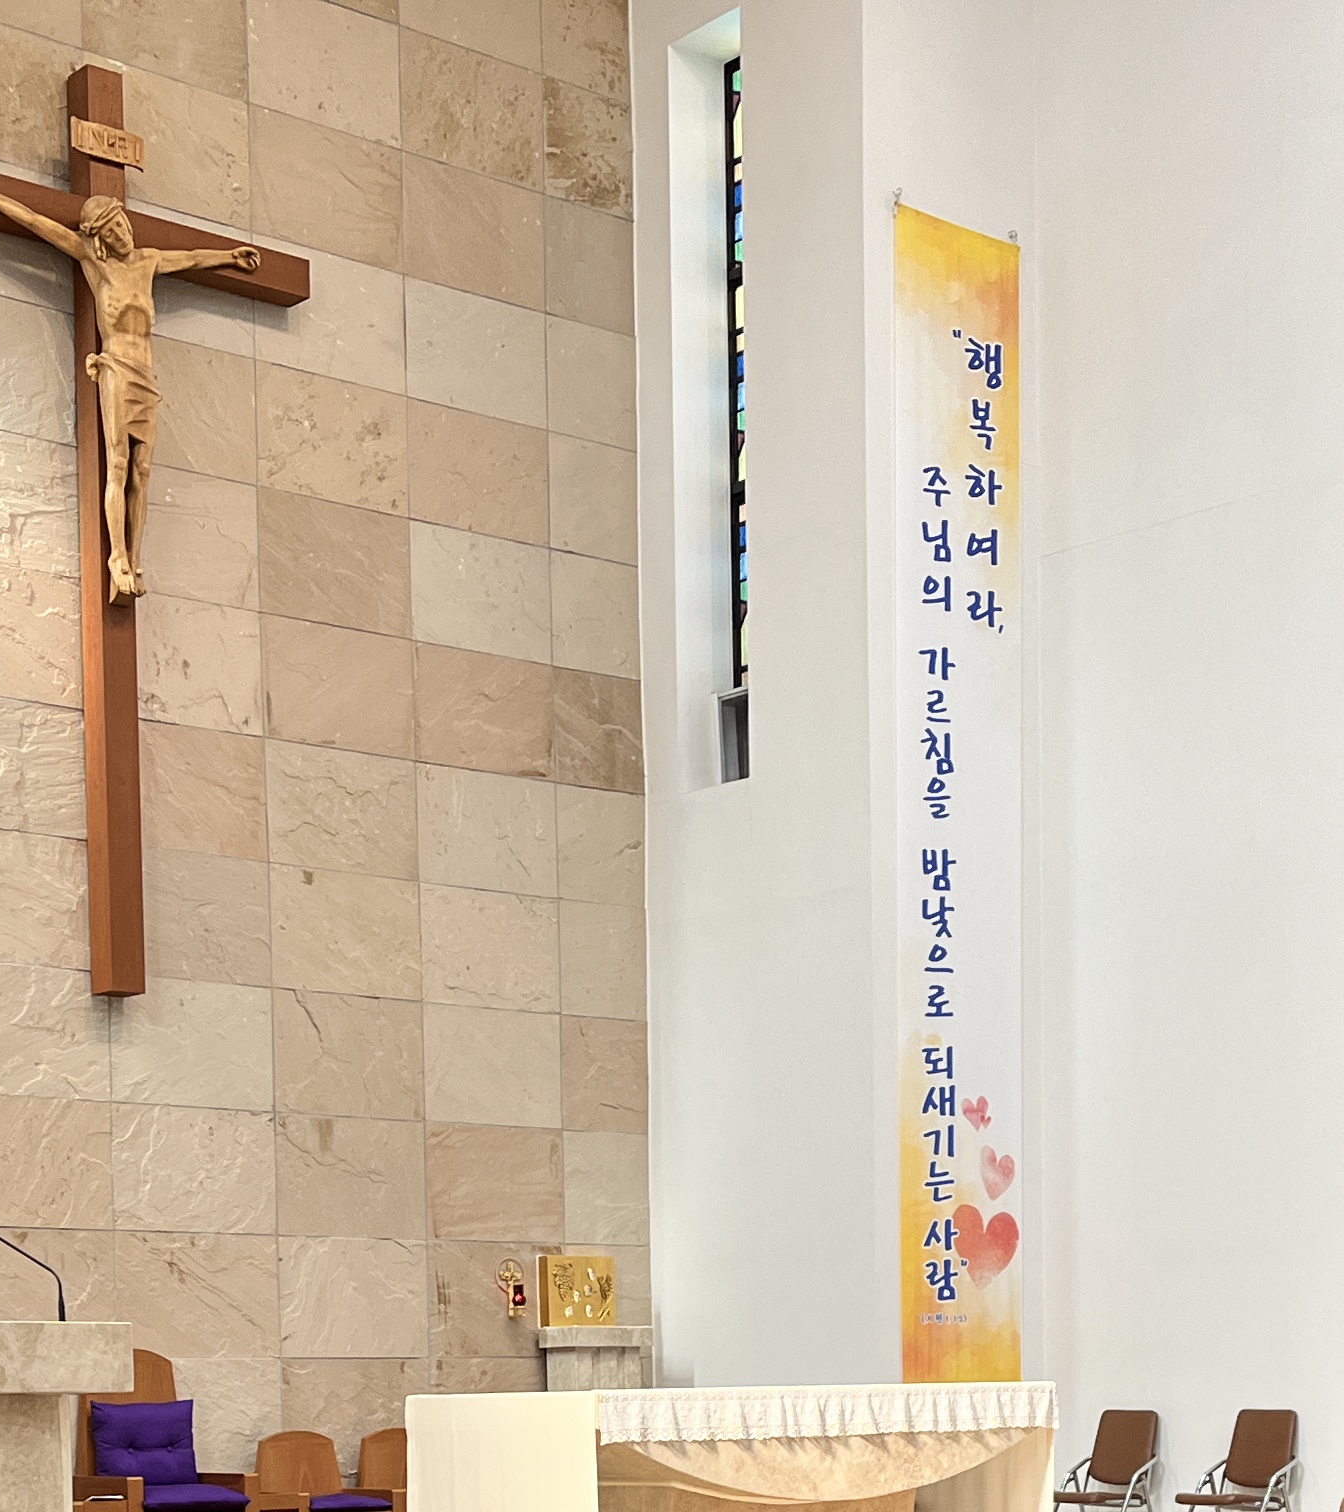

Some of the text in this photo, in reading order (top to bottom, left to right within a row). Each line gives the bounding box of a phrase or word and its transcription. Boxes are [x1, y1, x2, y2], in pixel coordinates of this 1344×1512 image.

[921, 465, 952, 613] 주님의
[918, 646, 956, 819] 가르침을
[921, 847, 956, 1019] 밤낮으로
[921, 1045, 957, 1203] 되새기는
